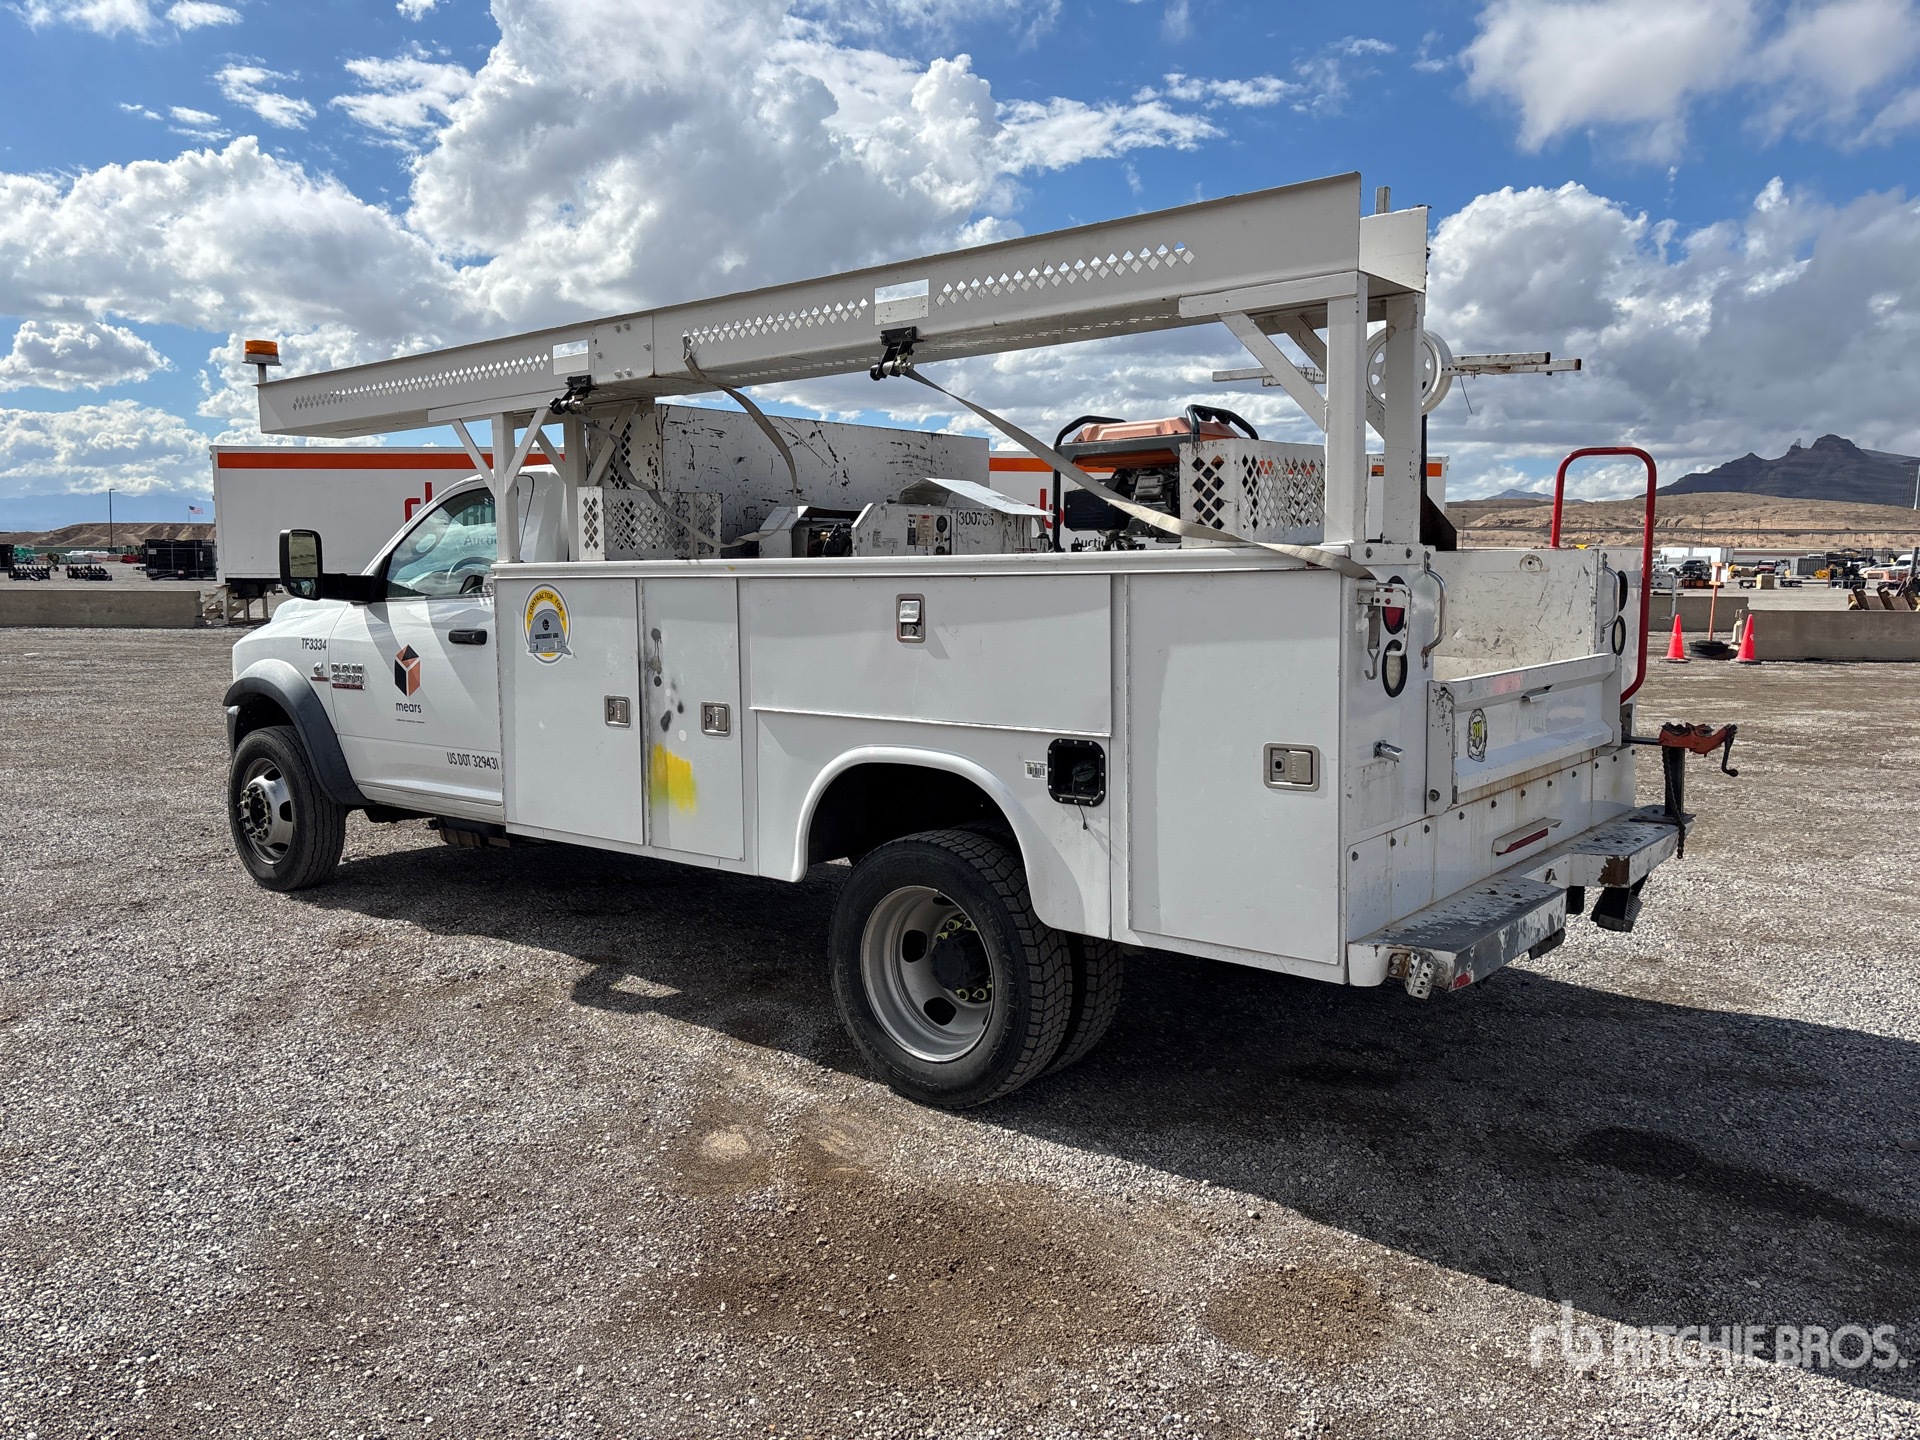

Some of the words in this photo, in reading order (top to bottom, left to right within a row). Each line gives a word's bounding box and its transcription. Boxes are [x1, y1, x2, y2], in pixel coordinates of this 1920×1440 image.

[301, 638, 327, 651] TF3334
[395, 702, 422, 714] mears
[446, 751, 458, 765] US
[457, 753, 472, 767] DOT
